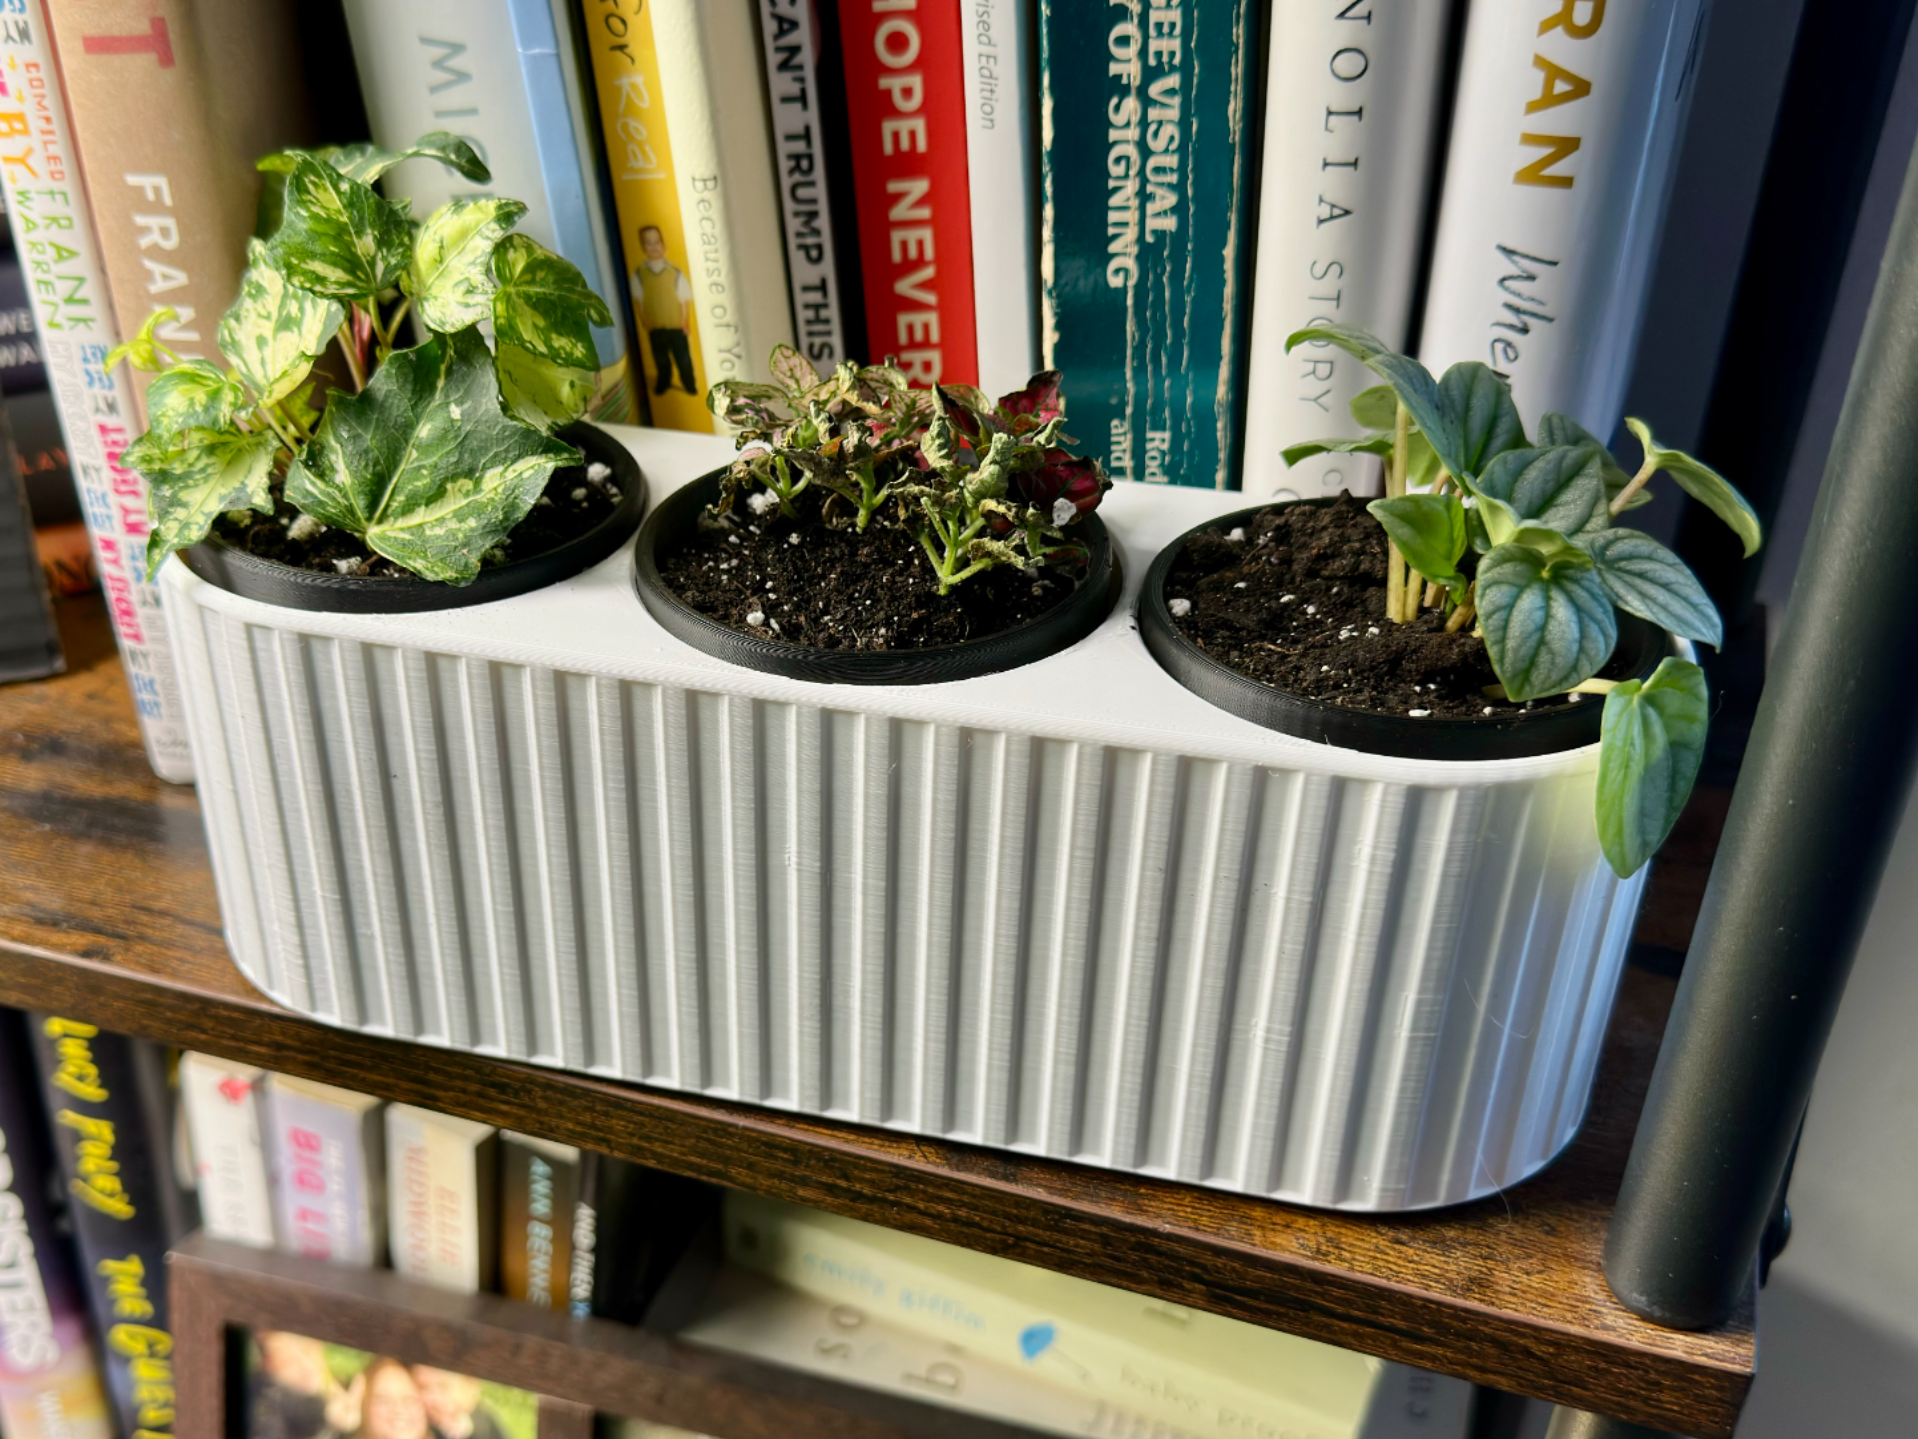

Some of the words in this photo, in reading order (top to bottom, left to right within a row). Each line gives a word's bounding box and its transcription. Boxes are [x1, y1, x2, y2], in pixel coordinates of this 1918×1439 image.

[82, 16, 176, 69] T
[768, 0, 808, 111] AN'T
[974, 0, 998, 48] ised
[1107, 20, 1142, 86] OF
[1147, 0, 1182, 67] EE
[24, 61, 66, 182] COMPILED
[613, 73, 667, 180] Real
[977, 52, 999, 130] Edition
[1315, 0, 1372, 229] NOLIA
[1512, 0, 1606, 189] RAN
[0, 112, 39, 180] BY
[1146, 71, 1182, 243] VISUAL
[783, 124, 825, 266] TRUMP
[1106, 93, 1142, 289] SIGNING
[15, 189, 65, 330] WARREN
[36, 188, 97, 331] FRANK
[123, 173, 205, 363] FRAN
[691, 175, 726, 295] Because
[710, 304, 739, 334] of
[800, 277, 834, 363] THIS
[886, 177, 943, 385] NEVER
[1489, 243, 1560, 380] Whe
[716, 341, 743, 382] Yo
[1110, 418, 1134, 467] and
[1144, 430, 1171, 483] Rod
[98, 536, 126, 570] MY
[119, 504, 151, 536] MY
[105, 572, 146, 646] SECRET
[287, 1125, 327, 1196] BIG
[528, 1155, 554, 1220] ANN
[526, 1220, 554, 1307] BENNE
